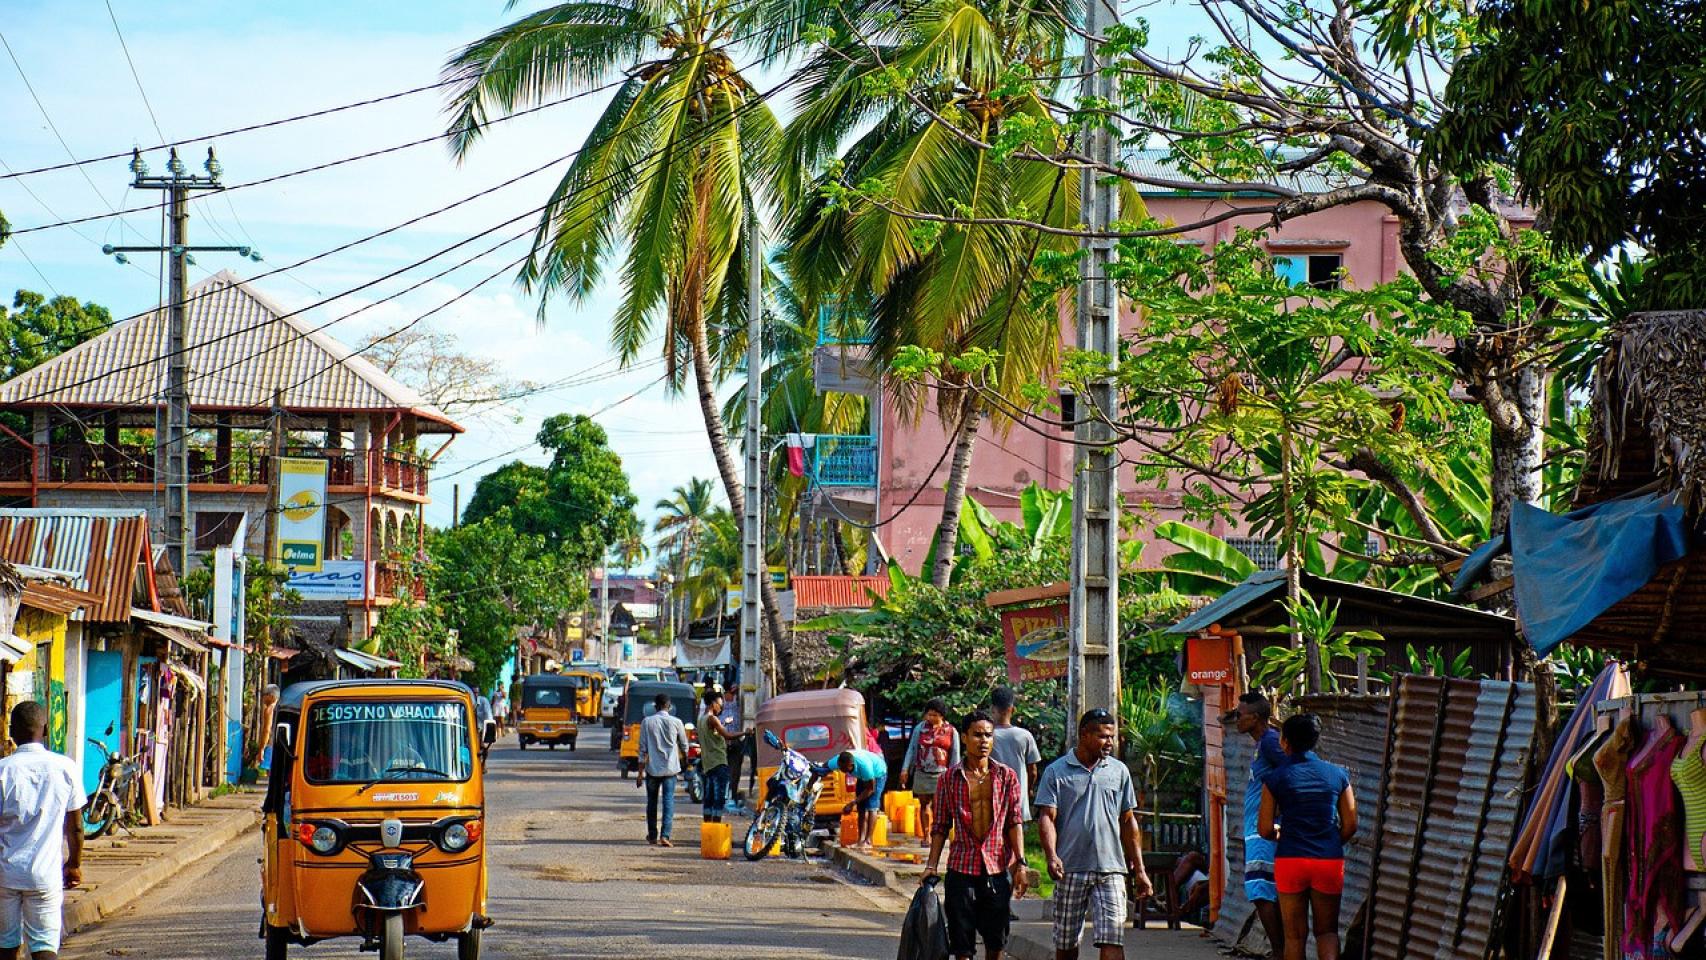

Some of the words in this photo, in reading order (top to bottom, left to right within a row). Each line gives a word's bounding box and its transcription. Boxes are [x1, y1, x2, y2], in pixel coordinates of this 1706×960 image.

[1191, 671, 1227, 681] orange
[313, 706, 362, 721] JESOSY
[364, 706, 385, 719] NO
